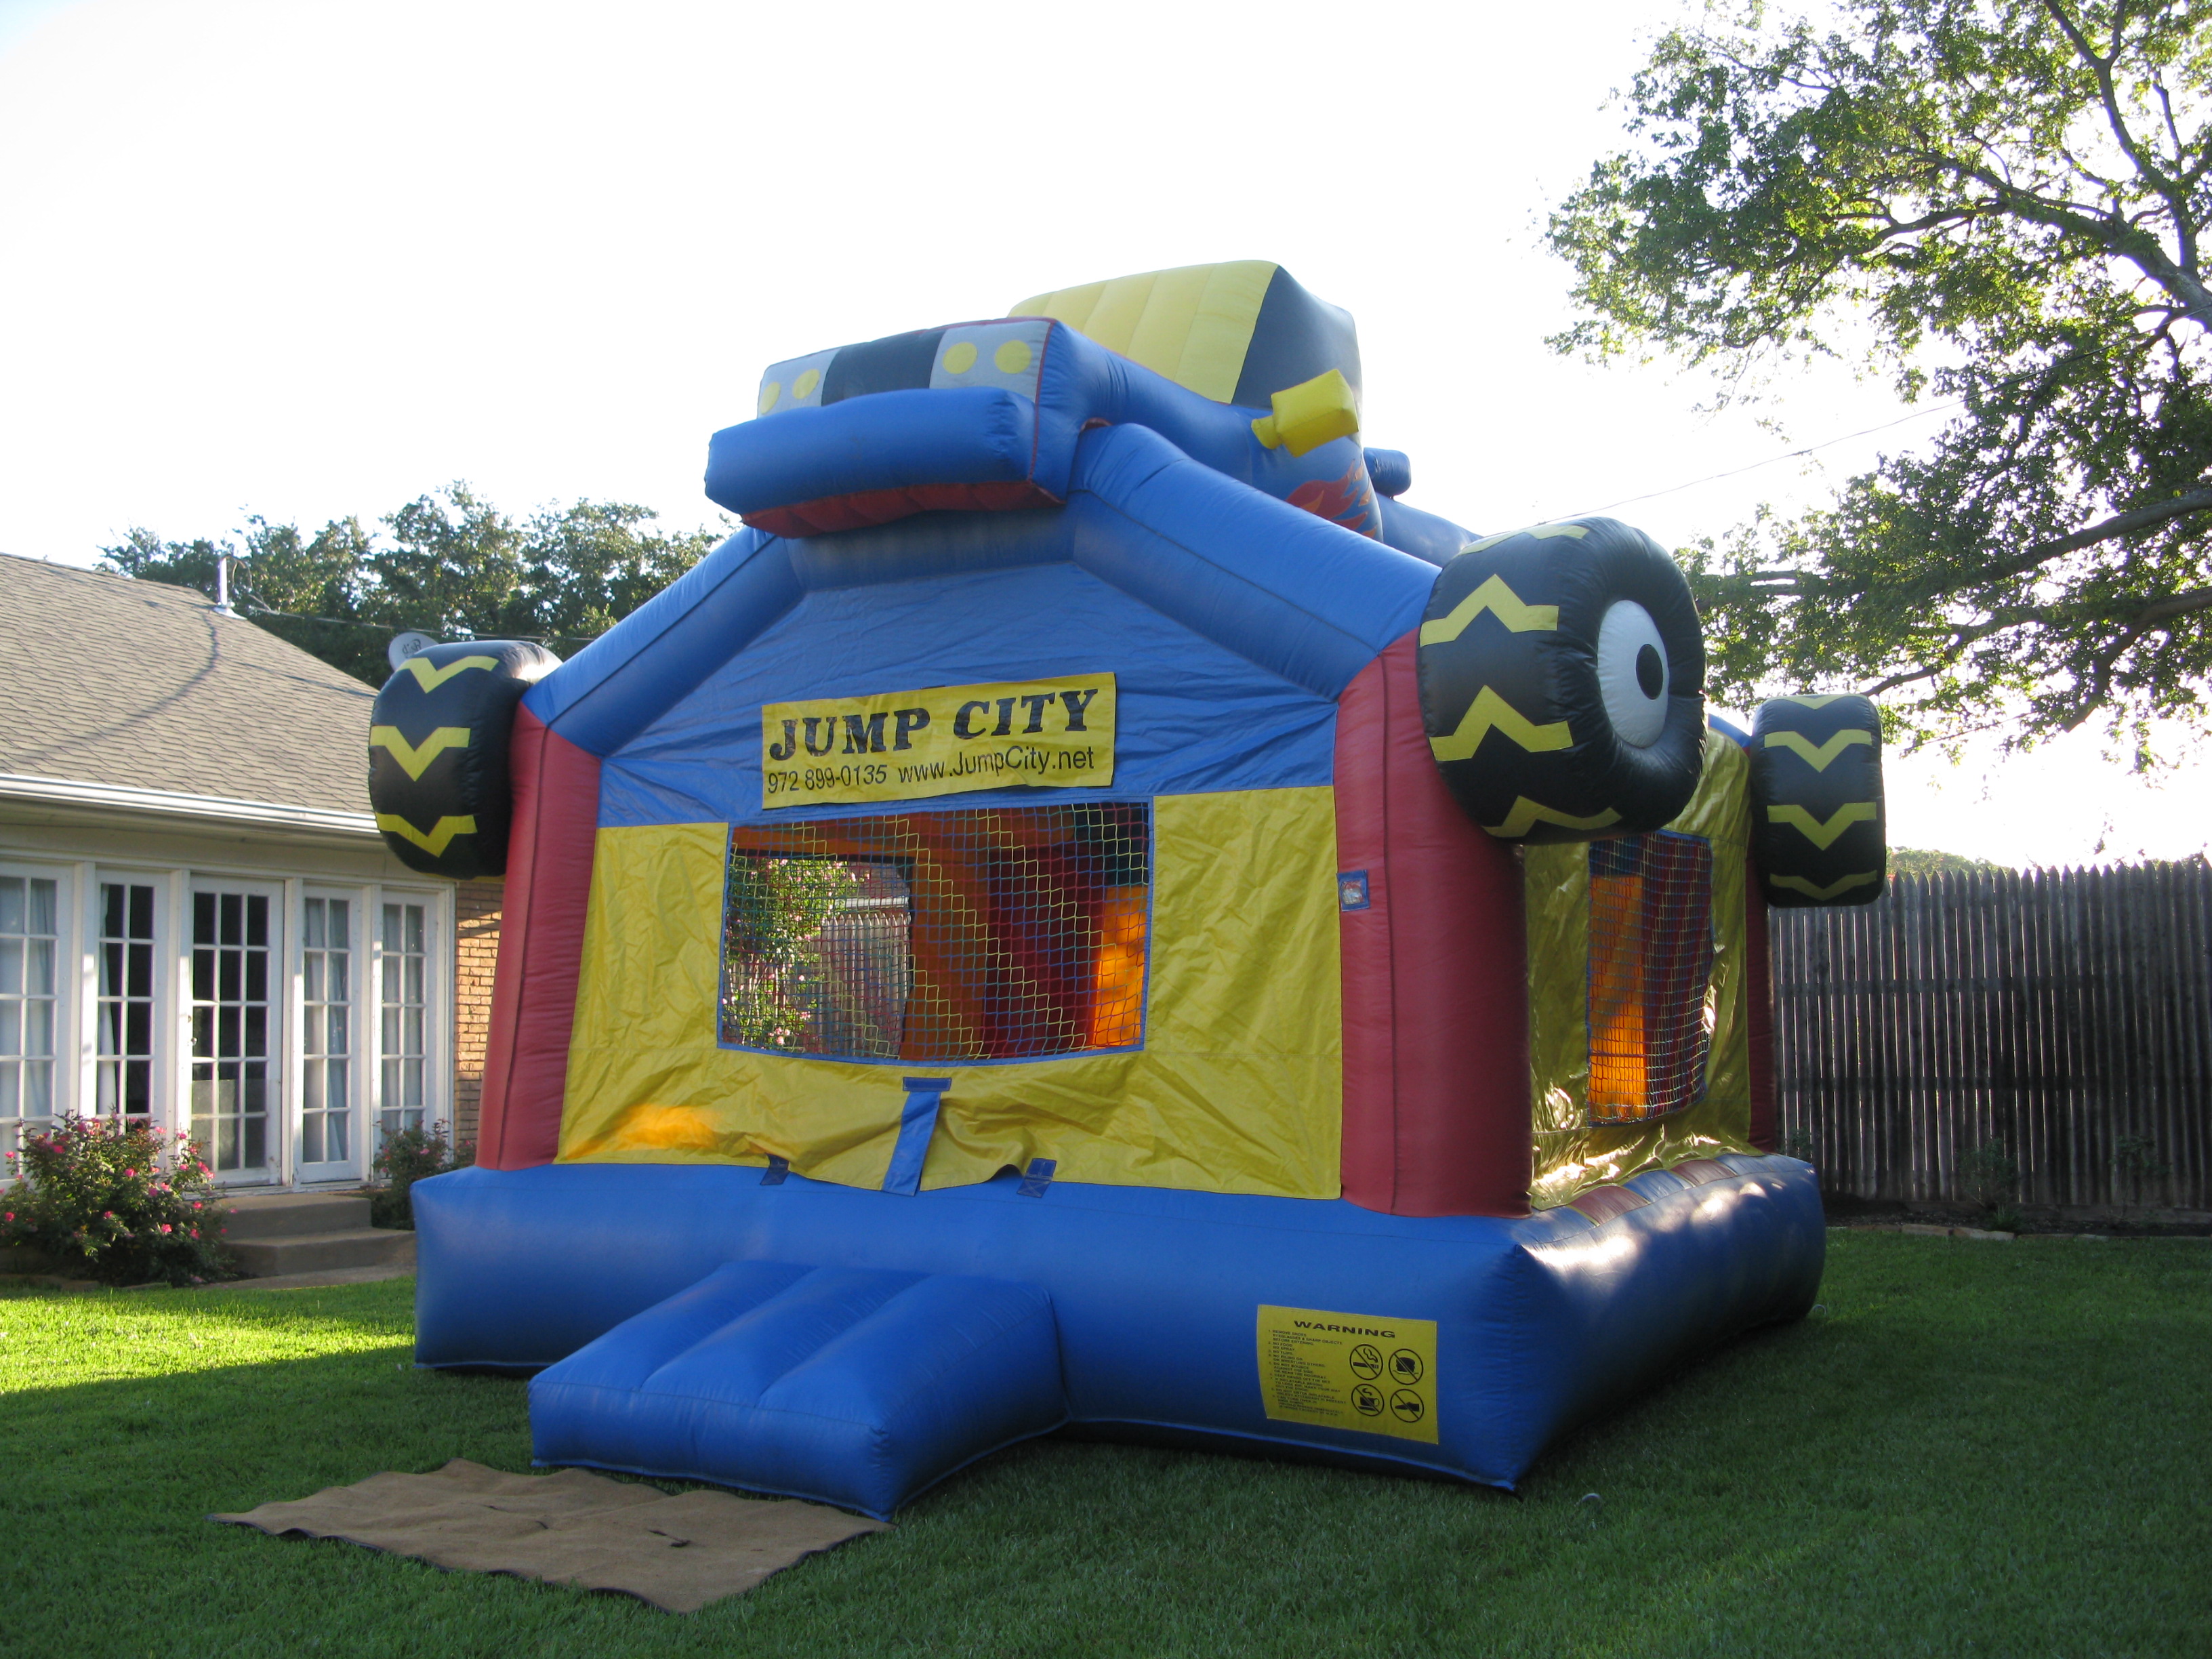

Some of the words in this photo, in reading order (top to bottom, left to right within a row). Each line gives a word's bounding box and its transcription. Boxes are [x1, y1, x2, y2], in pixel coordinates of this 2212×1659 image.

[769, 708, 930, 761] JUMP
[953, 689, 1099, 740] CITY
[768, 771, 799, 794] 972
[804, 764, 887, 791] 899-0135
[898, 745, 1094, 784] www.JumpCity.net
[1294, 1320, 1395, 1338] WARNING
